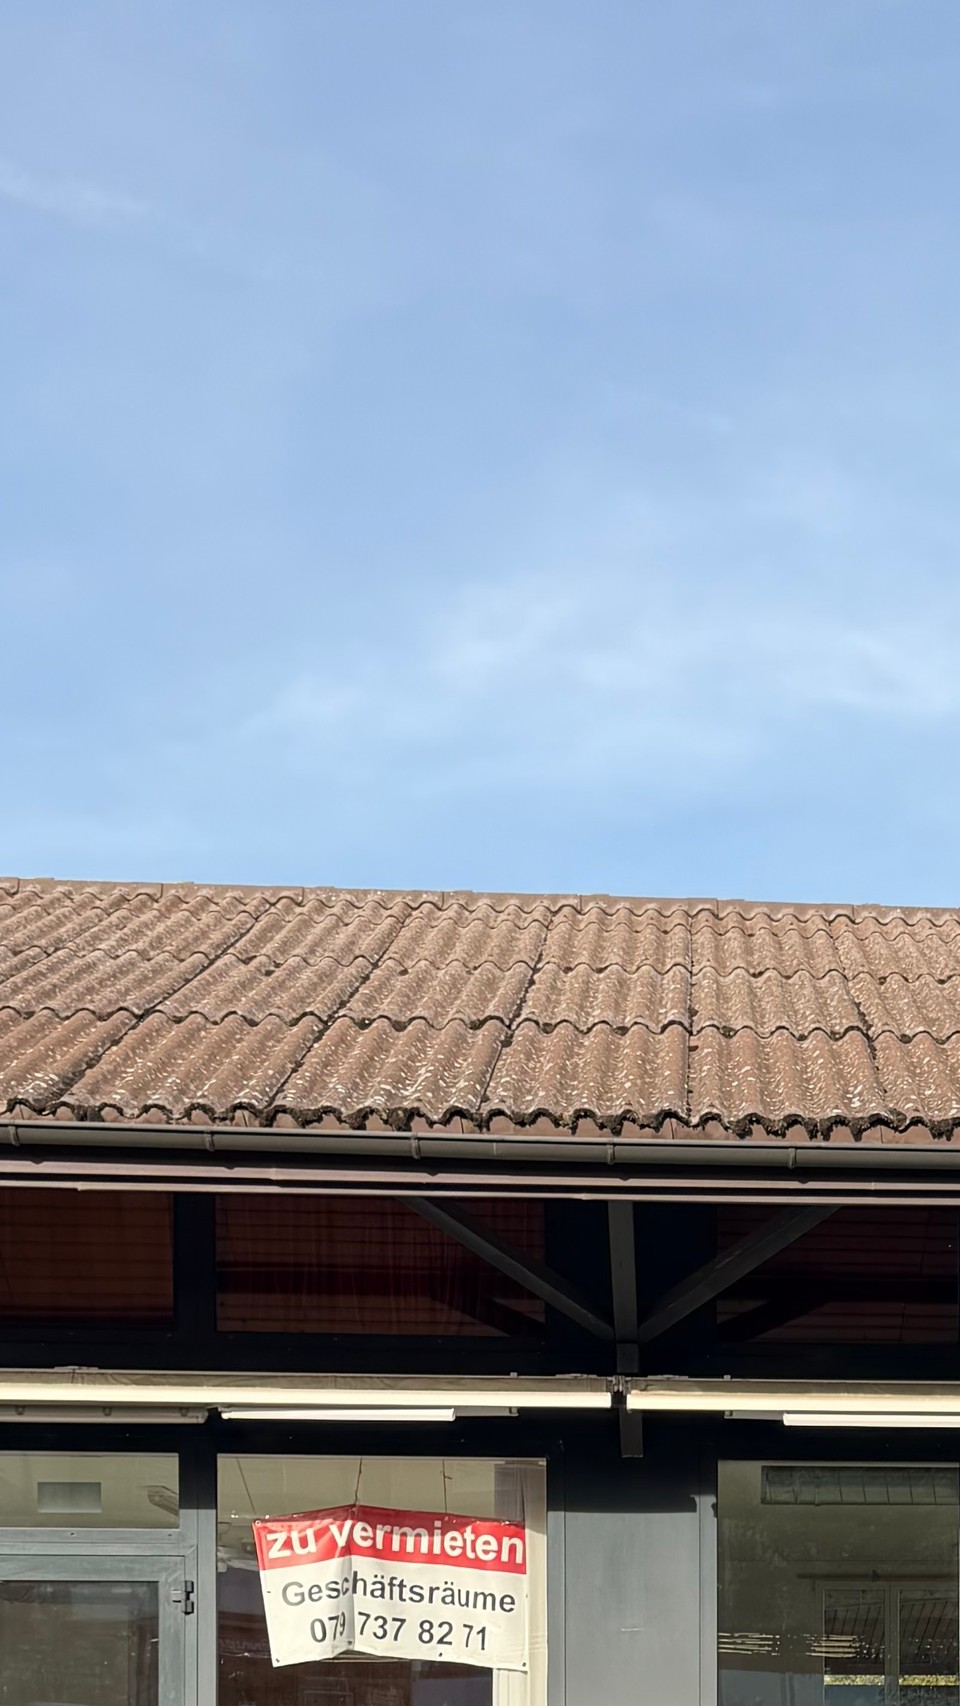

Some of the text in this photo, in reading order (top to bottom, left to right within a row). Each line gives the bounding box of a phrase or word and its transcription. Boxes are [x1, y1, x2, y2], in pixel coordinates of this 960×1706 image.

[266, 1519, 524, 1565] zu vermieten
[281, 1570, 516, 1613] Geschäftsräume
[310, 1611, 487, 1651] 079 737 82 71
